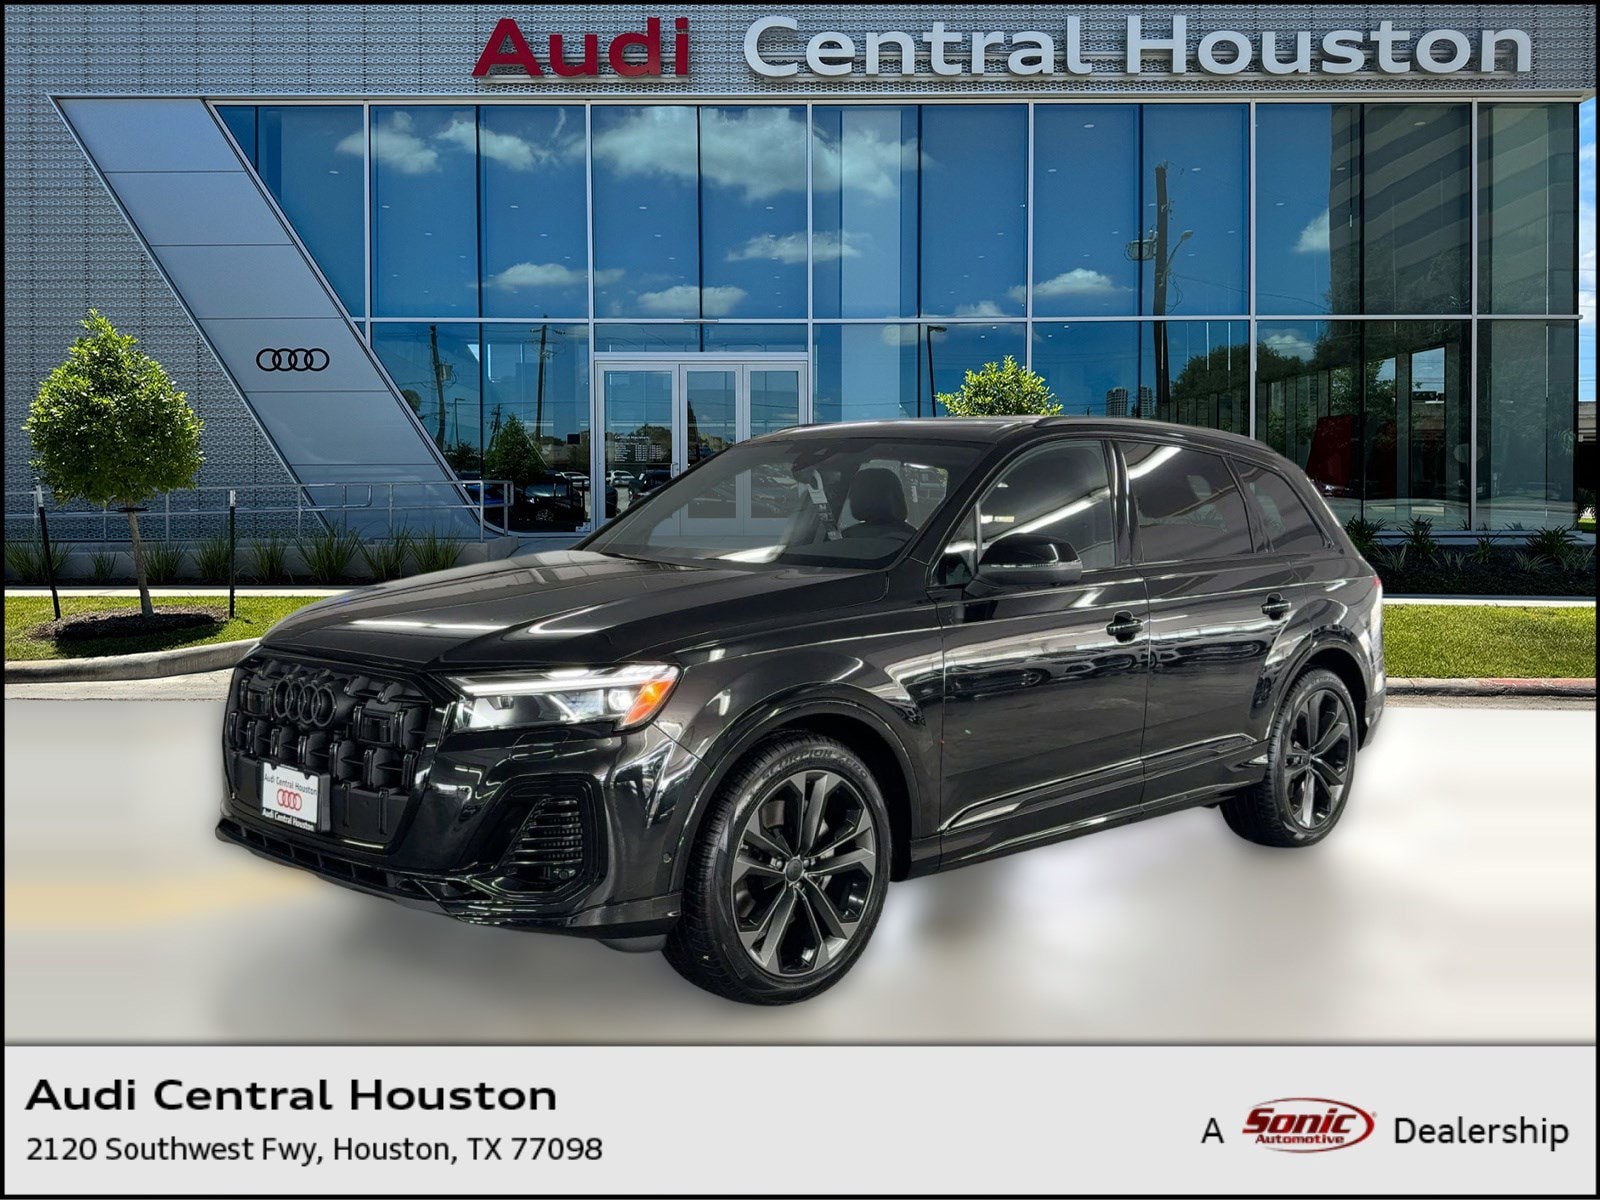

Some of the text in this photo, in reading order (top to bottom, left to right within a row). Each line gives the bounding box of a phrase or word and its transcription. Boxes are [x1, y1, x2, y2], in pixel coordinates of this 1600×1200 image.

[472, 15, 1532, 78] Audi Central Houston
[264, 773, 318, 796] Audi Central Houston
[262, 808, 315, 832] Audi Central Houston
